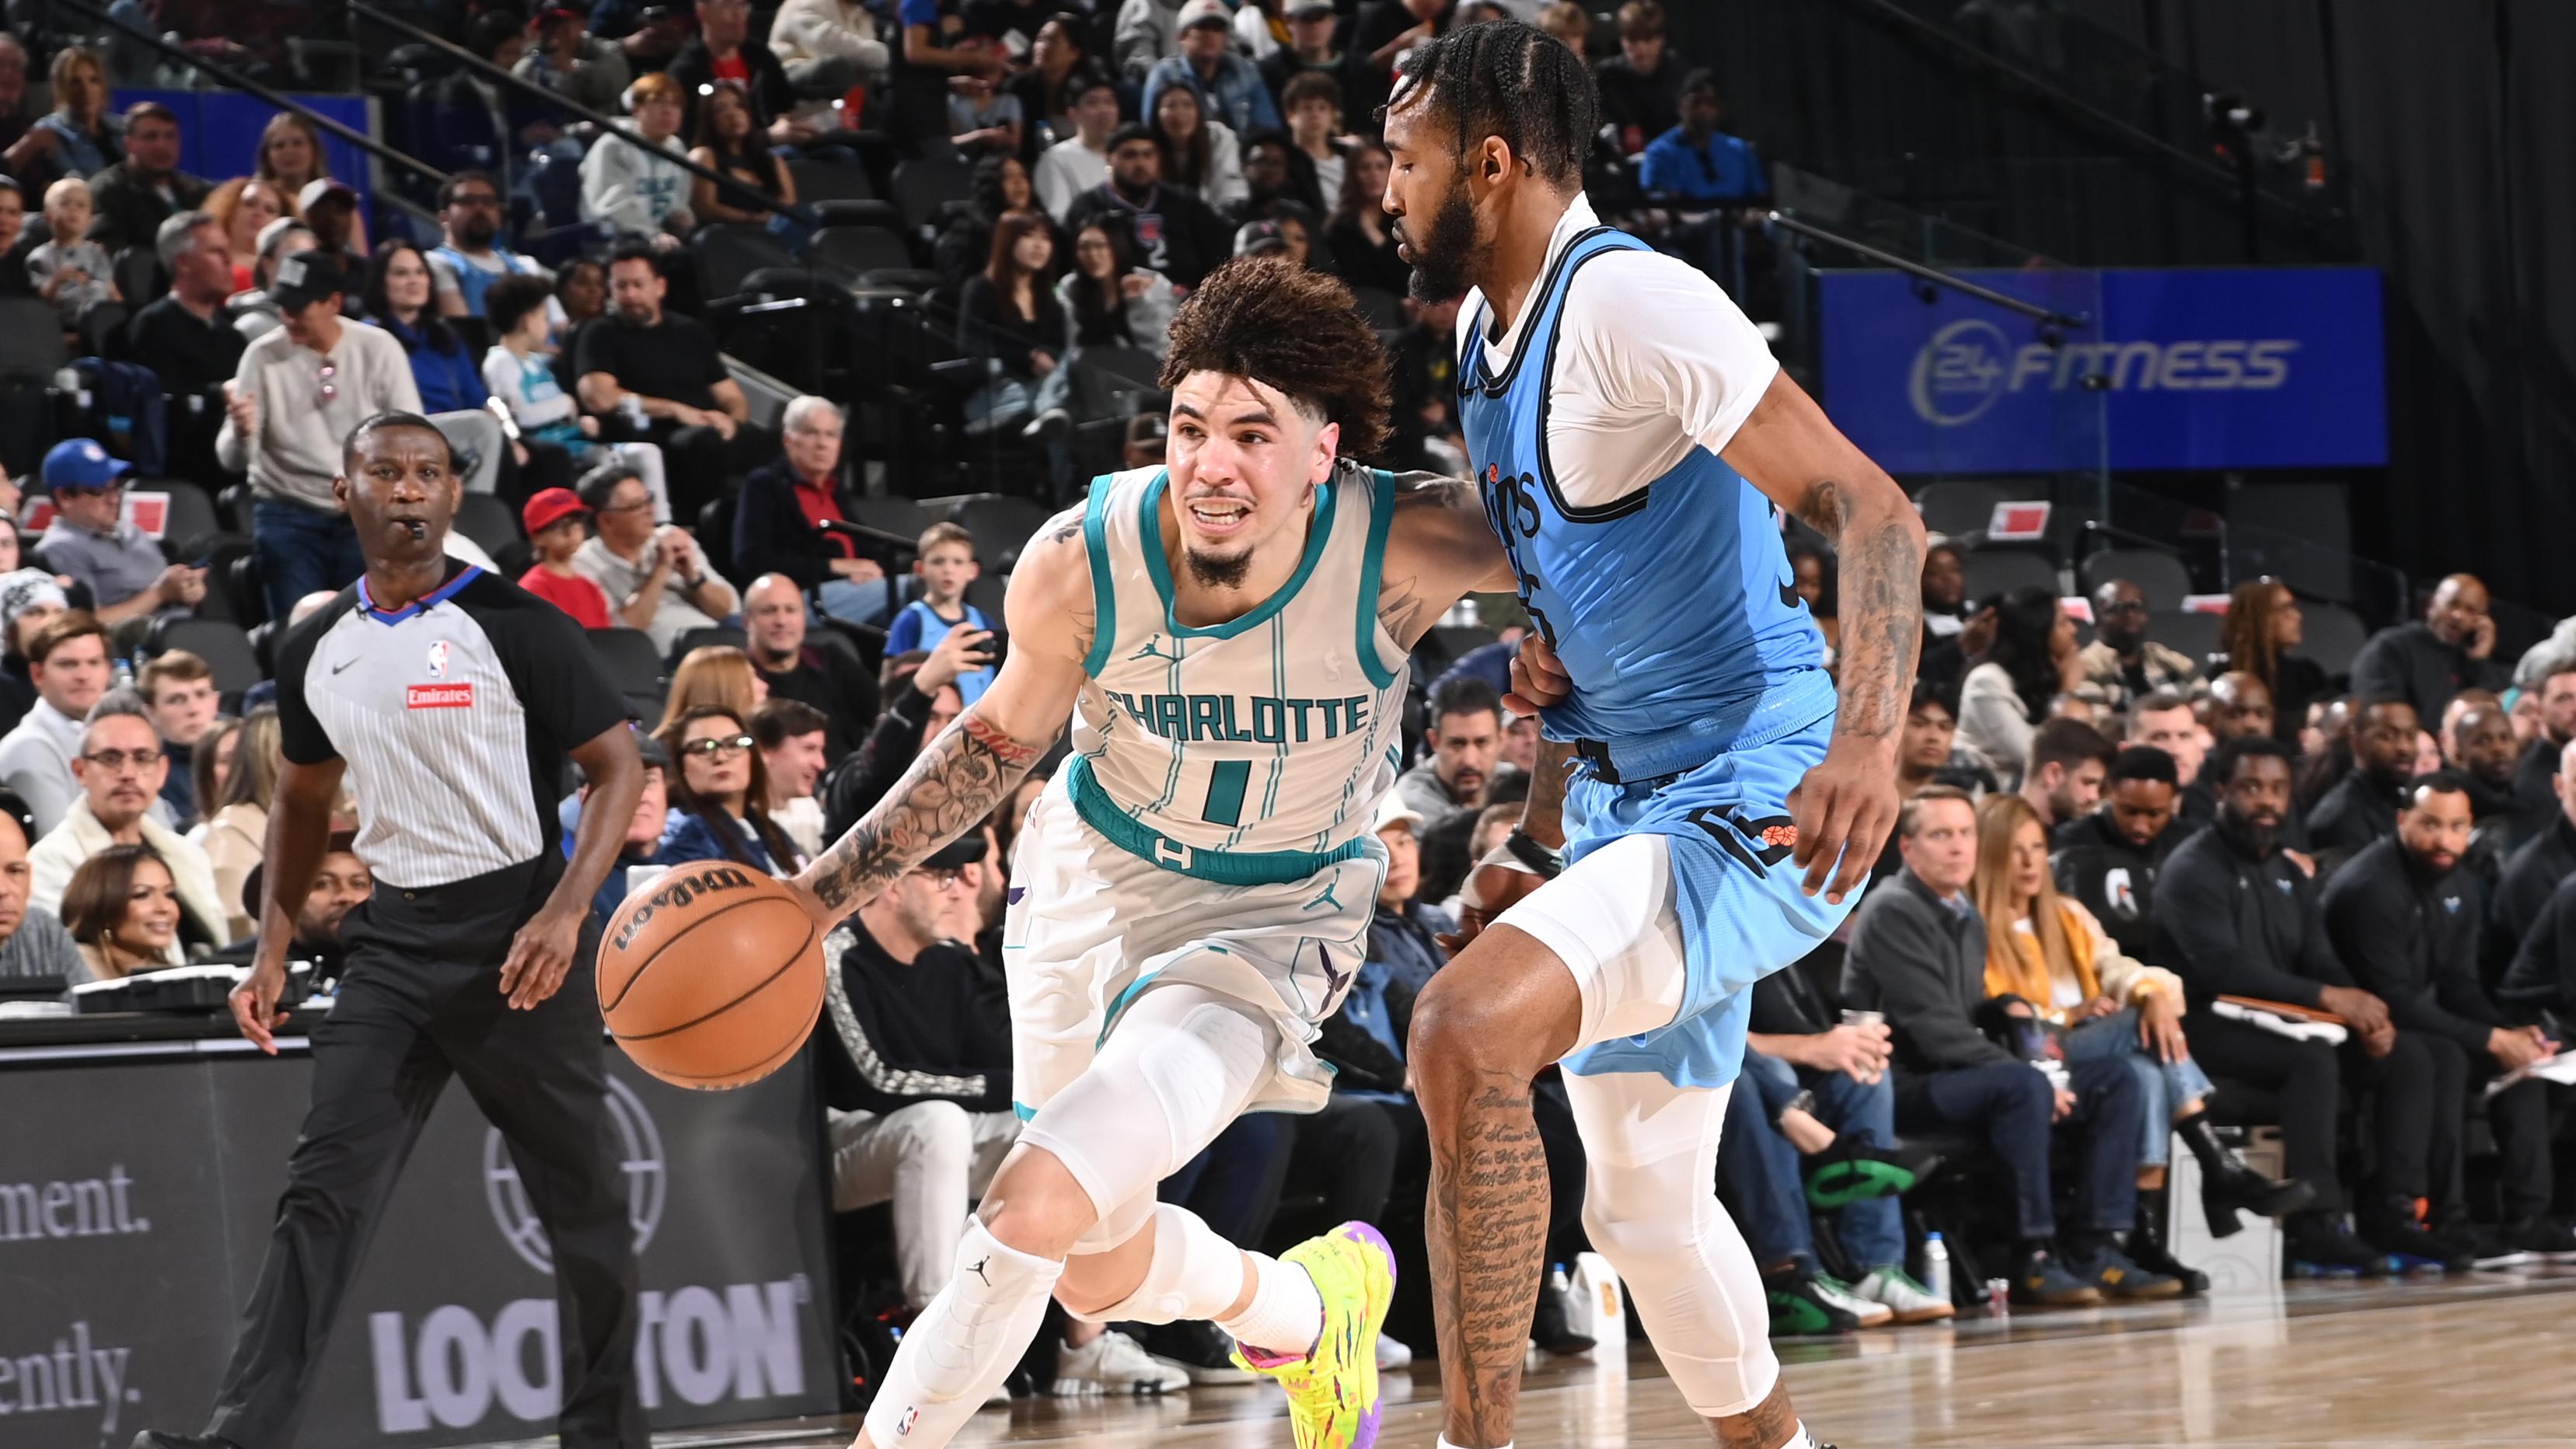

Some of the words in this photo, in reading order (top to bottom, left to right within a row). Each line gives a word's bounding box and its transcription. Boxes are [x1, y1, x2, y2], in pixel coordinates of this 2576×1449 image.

[2006, 340, 2302, 393] FITNESS
[408, 689, 471, 705] Emirates
[1200, 759, 1253, 828] 1
[0, 1164, 151, 1241] ment.
[368, 1280, 806, 1434] LOCTON
